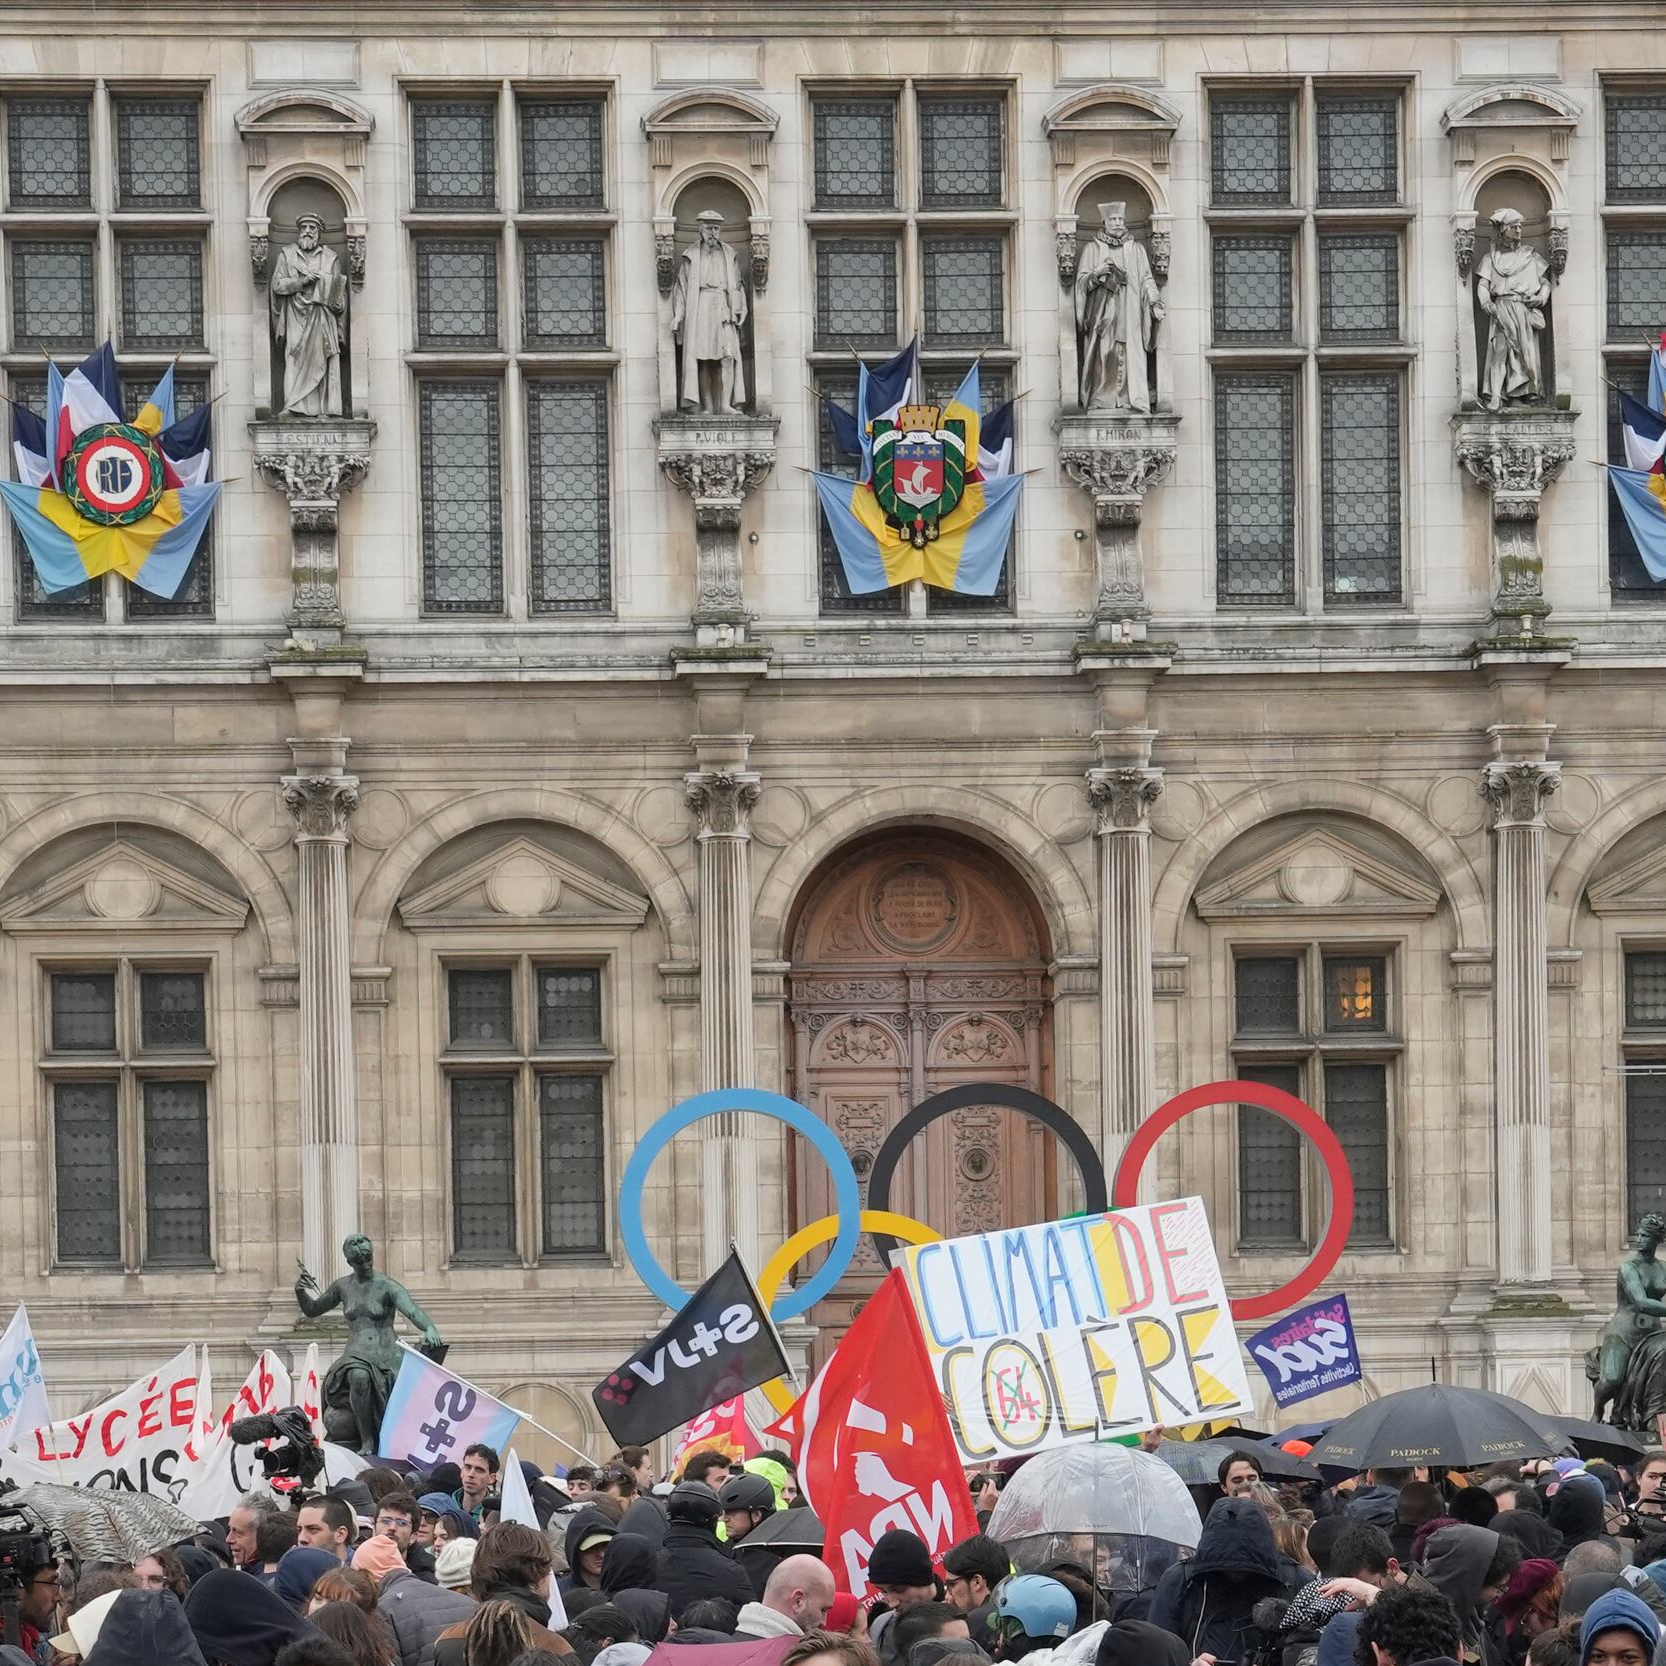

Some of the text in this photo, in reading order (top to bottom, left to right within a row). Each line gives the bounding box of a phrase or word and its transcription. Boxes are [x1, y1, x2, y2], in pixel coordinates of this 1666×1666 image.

[1102, 1202, 1209, 1316] DE
[942, 1304, 1241, 1460] COLÈRE
[1390, 1447, 1441, 1458] PADDOCK
[1481, 1440, 1526, 1453] PADDOCK
